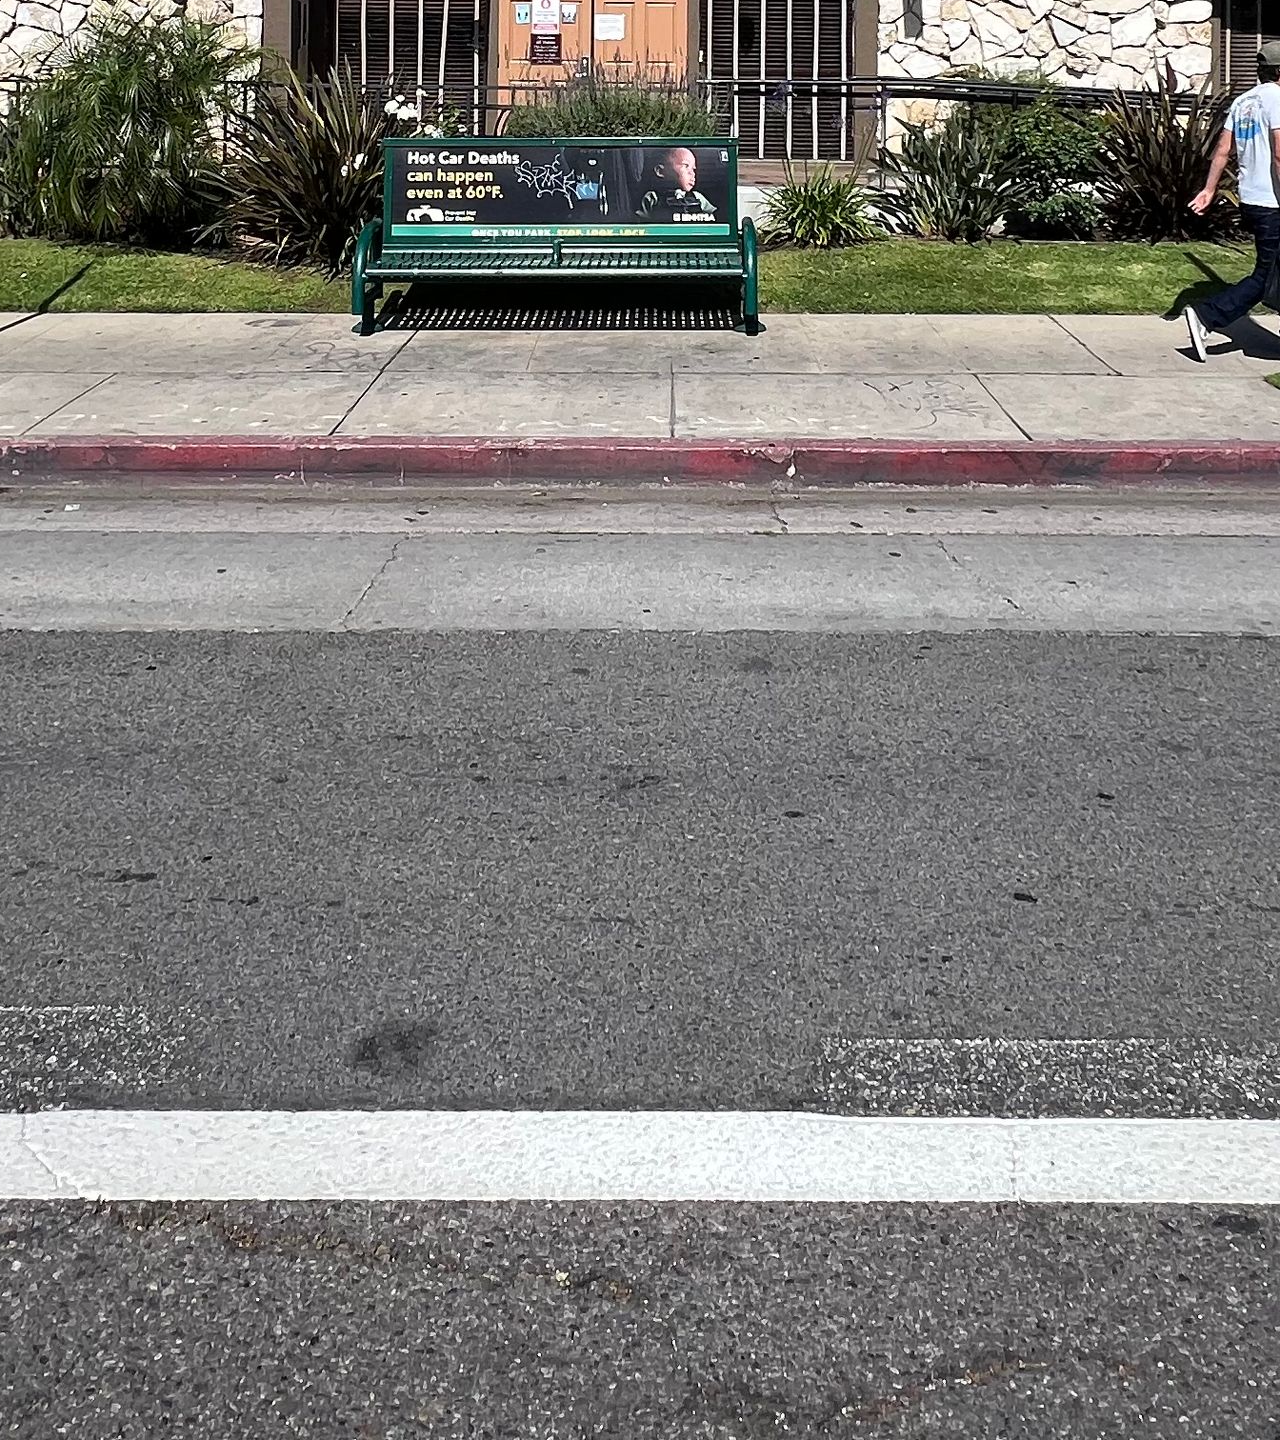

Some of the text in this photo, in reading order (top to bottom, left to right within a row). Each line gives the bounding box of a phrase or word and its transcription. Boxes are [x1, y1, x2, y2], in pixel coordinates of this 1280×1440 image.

[407, 150, 520, 165] Hot Car Deaths
[406, 168, 494, 185] can happen
[406, 188, 444, 199] even
[447, 186, 463, 199] at
